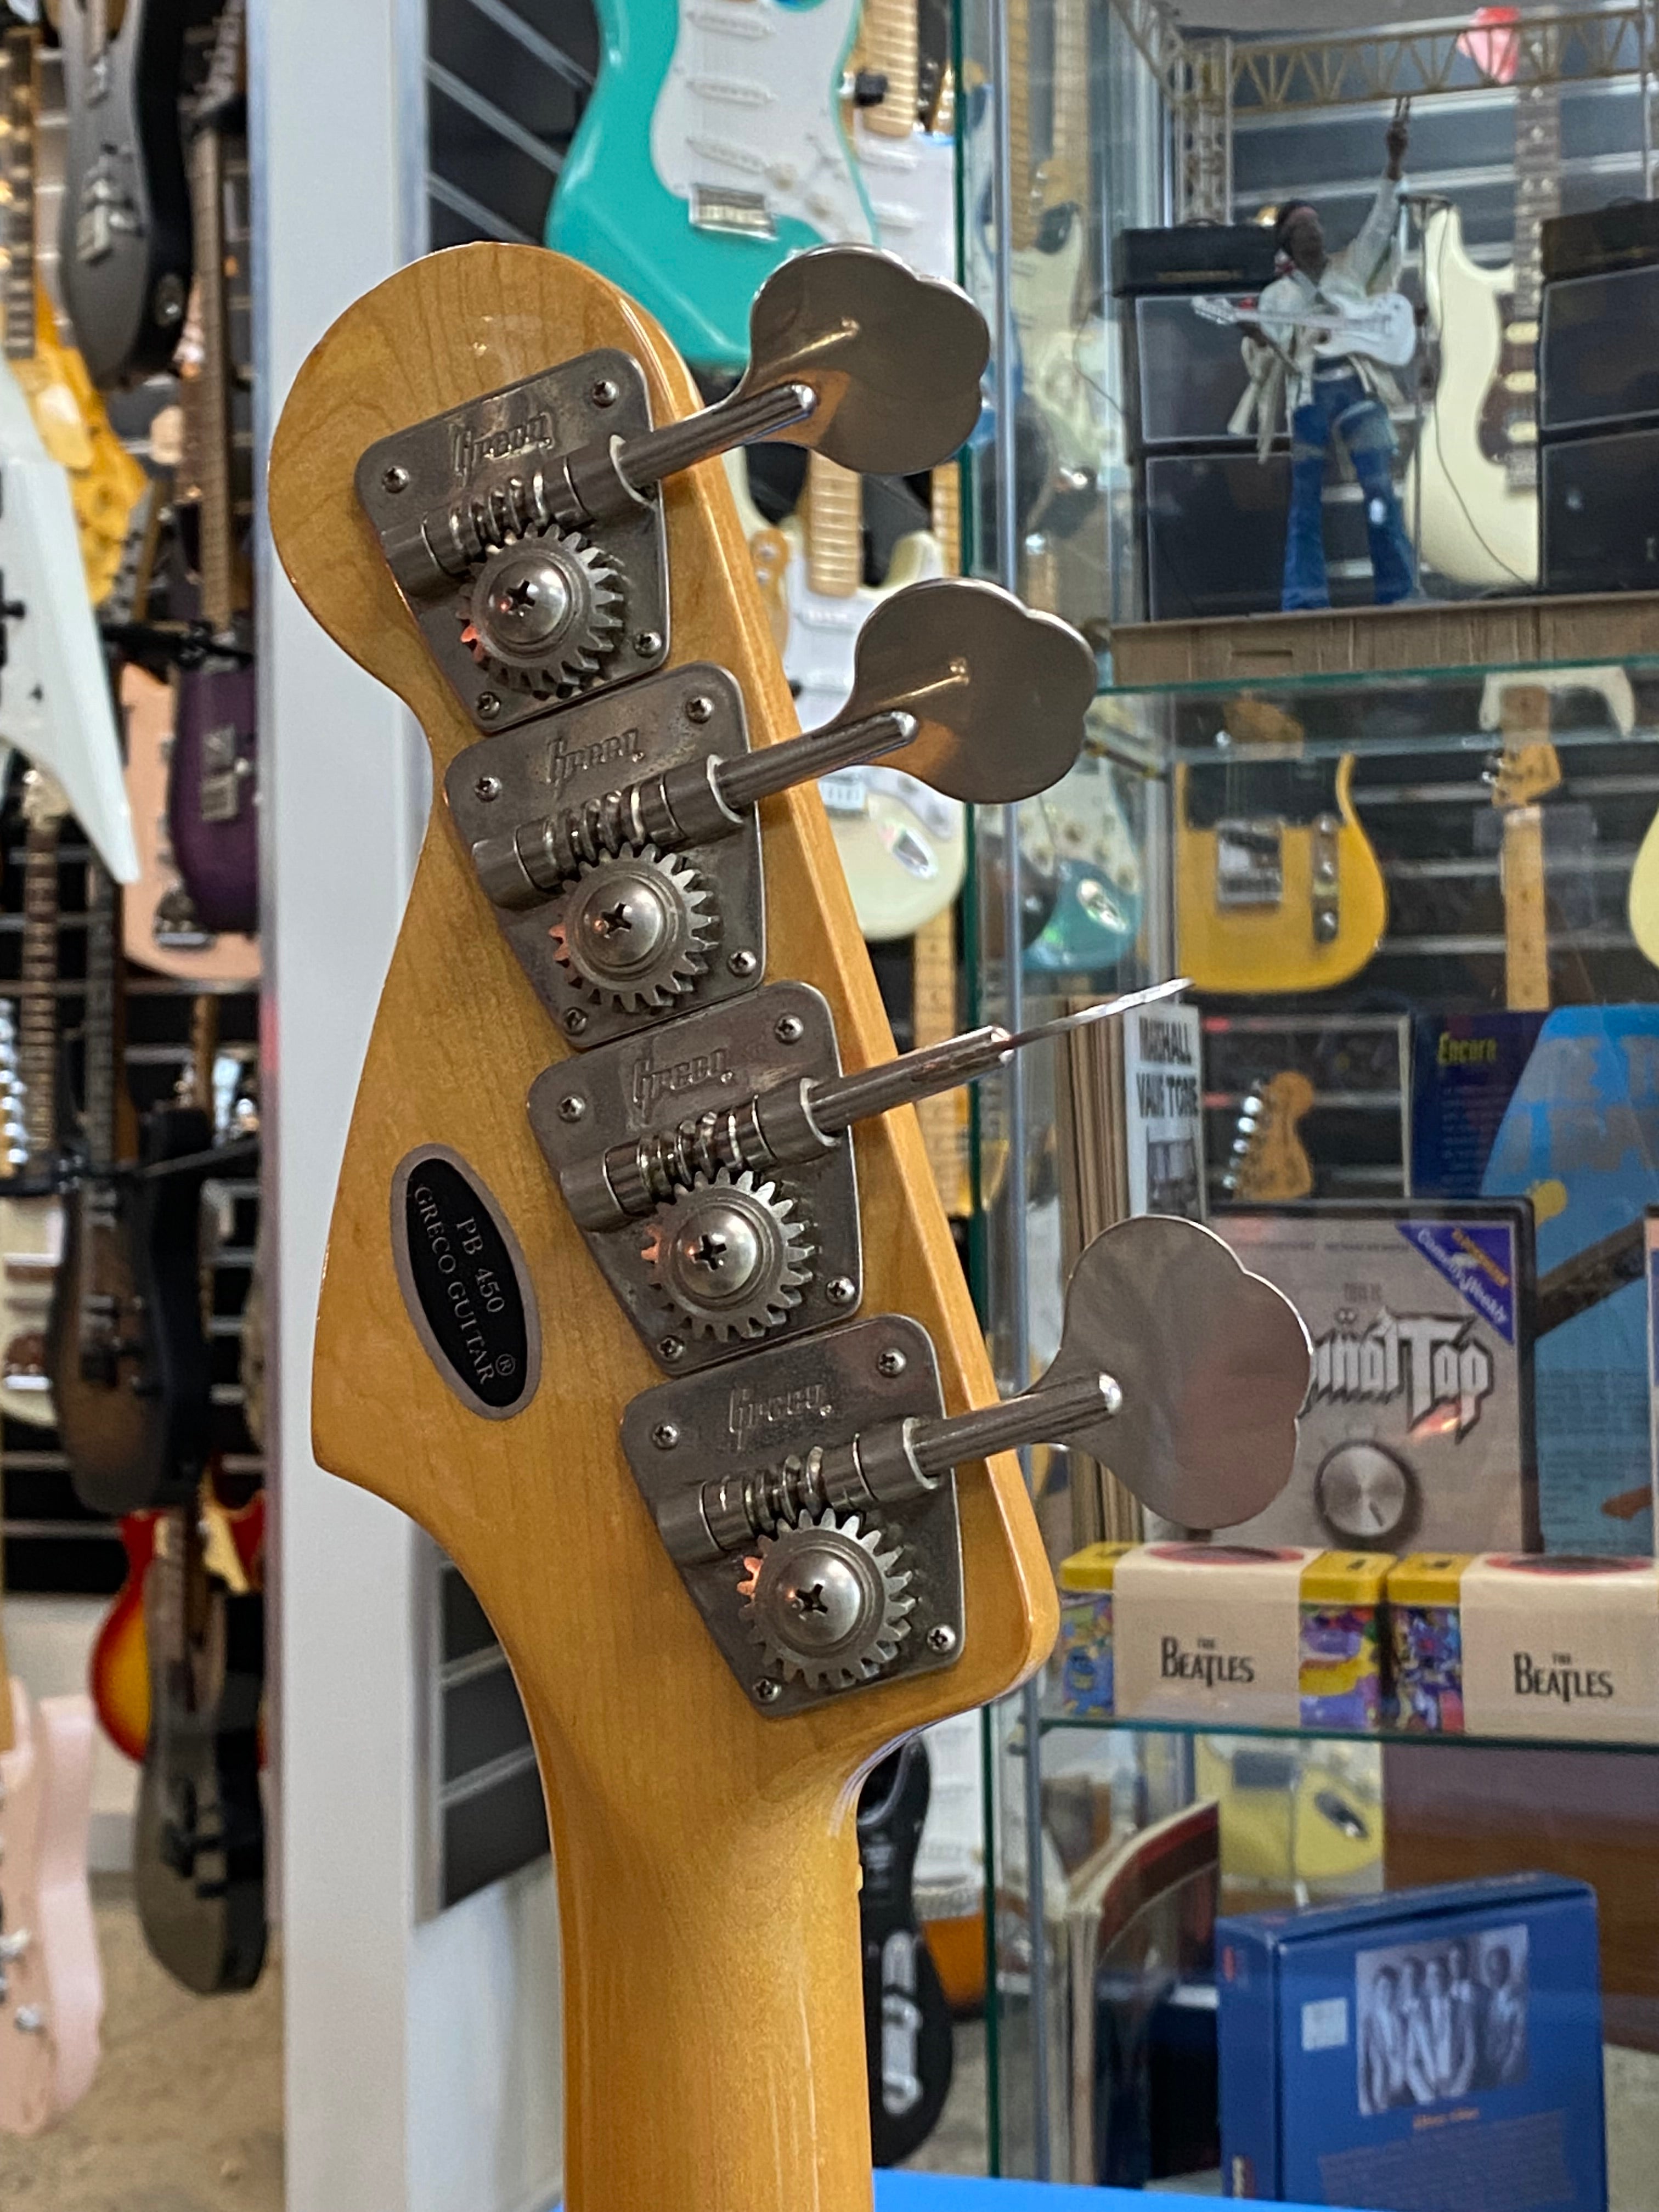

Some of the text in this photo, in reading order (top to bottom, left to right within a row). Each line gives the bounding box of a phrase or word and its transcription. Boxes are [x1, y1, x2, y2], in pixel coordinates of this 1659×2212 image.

[415, 1187, 456, 1274] GRECO
[447, 1282, 494, 1385] GUITAR
[456, 1216, 505, 1313] PB 450
[1161, 1635, 1255, 1688] BEATLES
[1514, 1651, 1613, 1702] BEATLES
